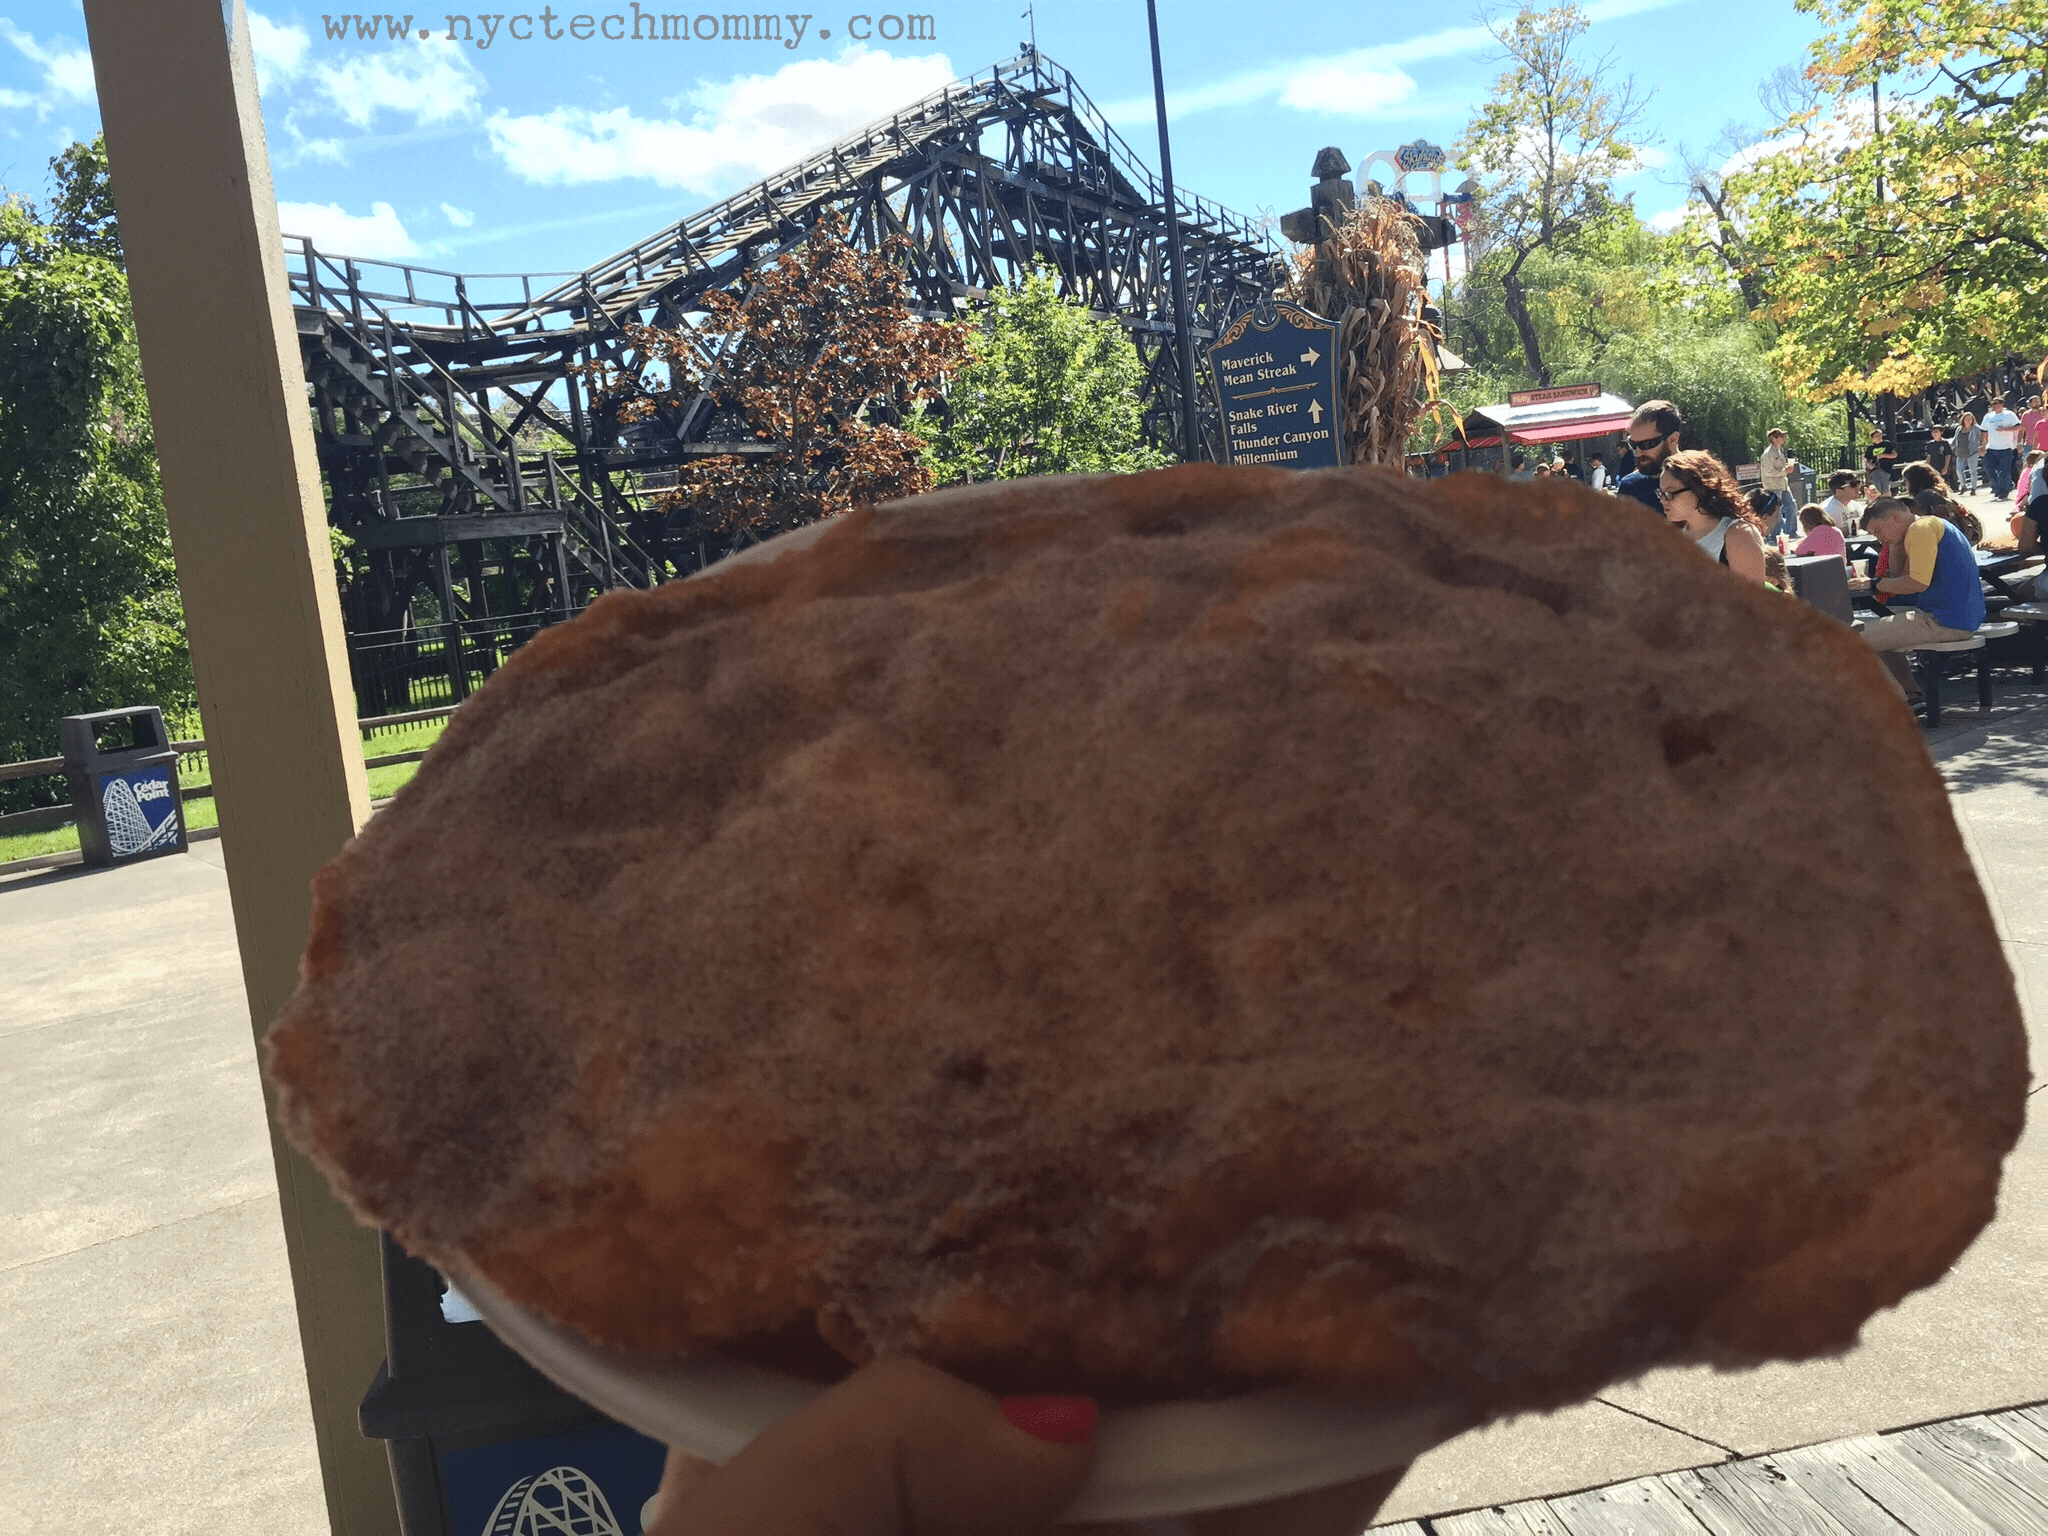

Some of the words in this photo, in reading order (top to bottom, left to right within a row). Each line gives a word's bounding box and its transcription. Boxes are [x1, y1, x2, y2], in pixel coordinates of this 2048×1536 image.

[1222, 352, 1273, 371] Maverick
[1223, 372, 1254, 387] Mean
[1257, 364, 1297, 381] Streak
[1530, 392, 1552, 401] STEAK
[1552, 388, 1588, 399] SANDWICH
[1228, 407, 1264, 422] Snake
[1267, 403, 1299, 417] River
[1230, 422, 1258, 436] Falls
[1232, 436, 1280, 451] Thunder
[1283, 429, 1329, 445] Canyon
[1234, 449, 1299, 466] Millennium
[133, 778, 169, 794] Cedar
[136, 788, 170, 803] Point
